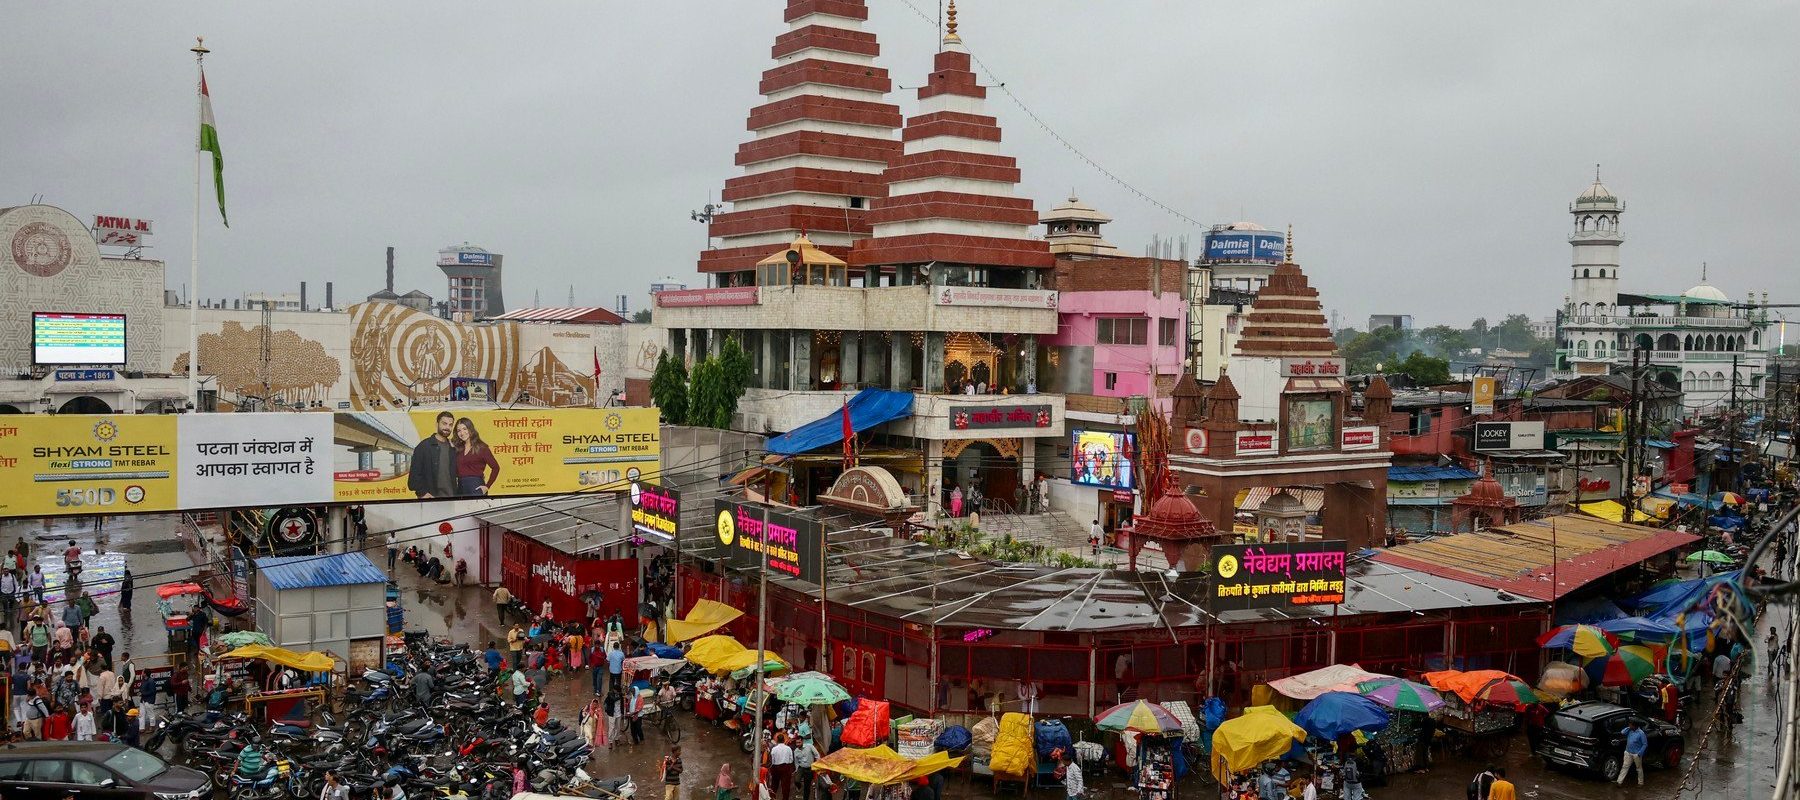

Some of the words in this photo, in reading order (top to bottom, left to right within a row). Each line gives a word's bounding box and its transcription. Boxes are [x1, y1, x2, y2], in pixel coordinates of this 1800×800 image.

[97, 216, 131, 230] PATNA
[1211, 240, 1250, 249] Dalmia
[1290, 360, 1316, 375] महावीर
[562, 434, 611, 444] SHYAM
[616, 433, 659, 443] STEEL
[1481, 429, 1507, 438] JOCKEY
[33, 446, 102, 458] SHYAM
[109, 445, 170, 456] STEEL
[197, 442, 239, 456] पटना
[242, 439, 296, 455] जंक्शन
[299, 437, 315, 453] में
[493, 442, 519, 455] हमेशा
[522, 442, 532, 453] के
[535, 442, 553, 454] लिए
[131, 459, 156, 467] REBAR
[196, 463, 248, 477] आपका
[252, 461, 301, 475] स्वागत
[304, 456, 315, 475] है
[56, 487, 116, 507] 550D
[1243, 548, 1291, 579] नैवेद्यम्
[1296, 552, 1344, 576] प्रसादम्
[1244, 583, 1250, 595] के
